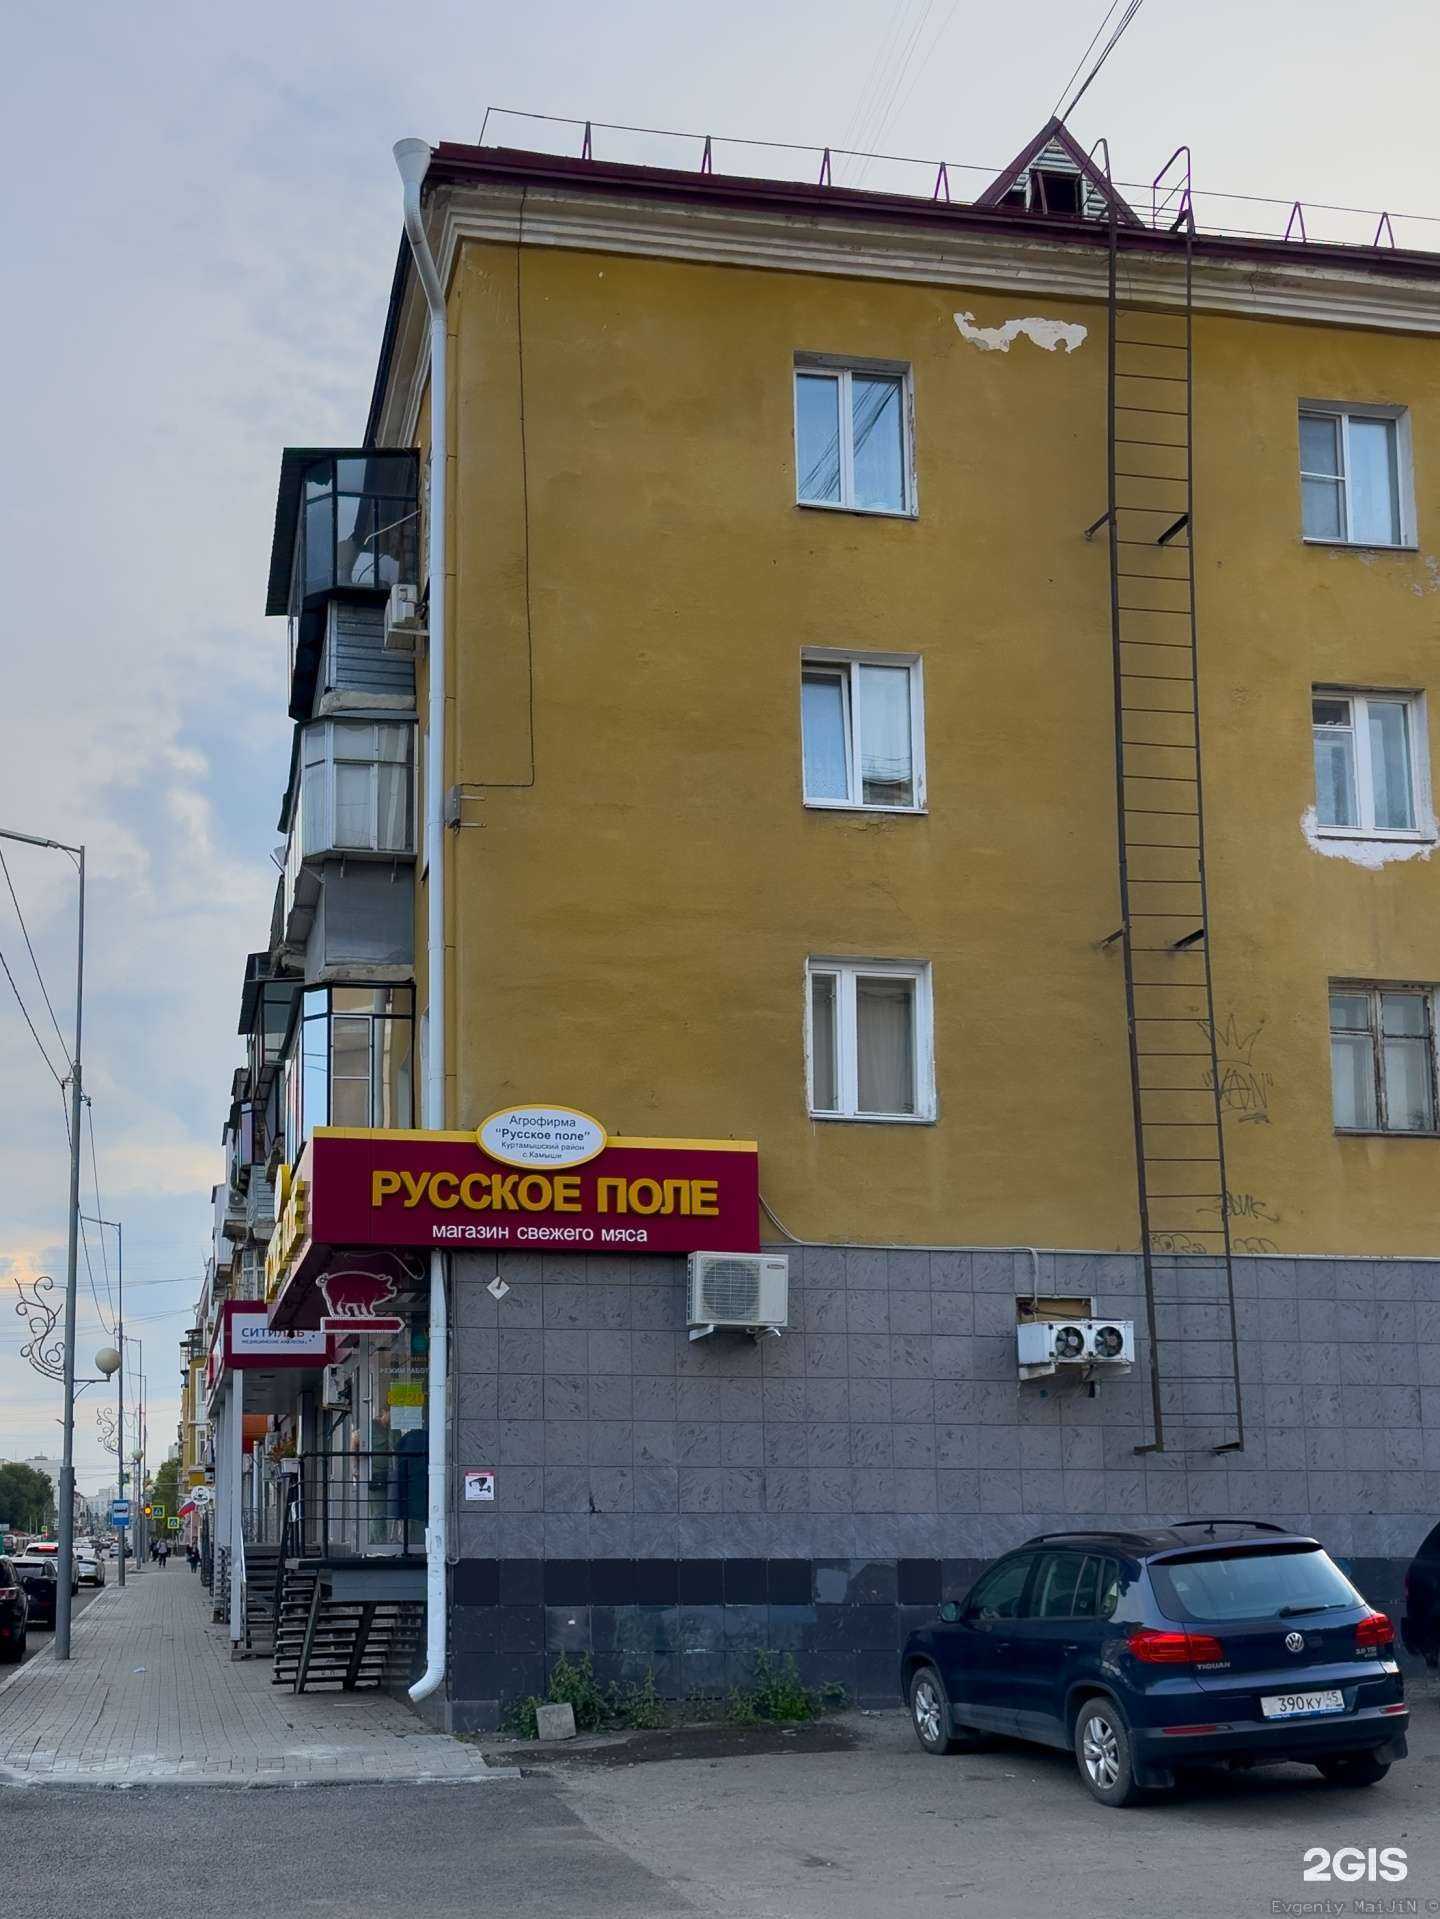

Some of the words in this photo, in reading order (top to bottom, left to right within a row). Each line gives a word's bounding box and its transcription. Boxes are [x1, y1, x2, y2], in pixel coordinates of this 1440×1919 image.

[509, 1115, 576, 1129] Агрофирма
[501, 1141, 559, 1150] Куртамышский
[561, 1144, 585, 1152] район
[529, 1151, 562, 1160] Камыши
[372, 1171, 582, 1212] РУССКОЕ
[597, 1177, 720, 1216] ПОЛЕ
[432, 1225, 509, 1239] магазин
[516, 1226, 594, 1241] свежего
[601, 1229, 648, 1242] мяса
[241, 1327, 305, 1338] СИТИЛБ
